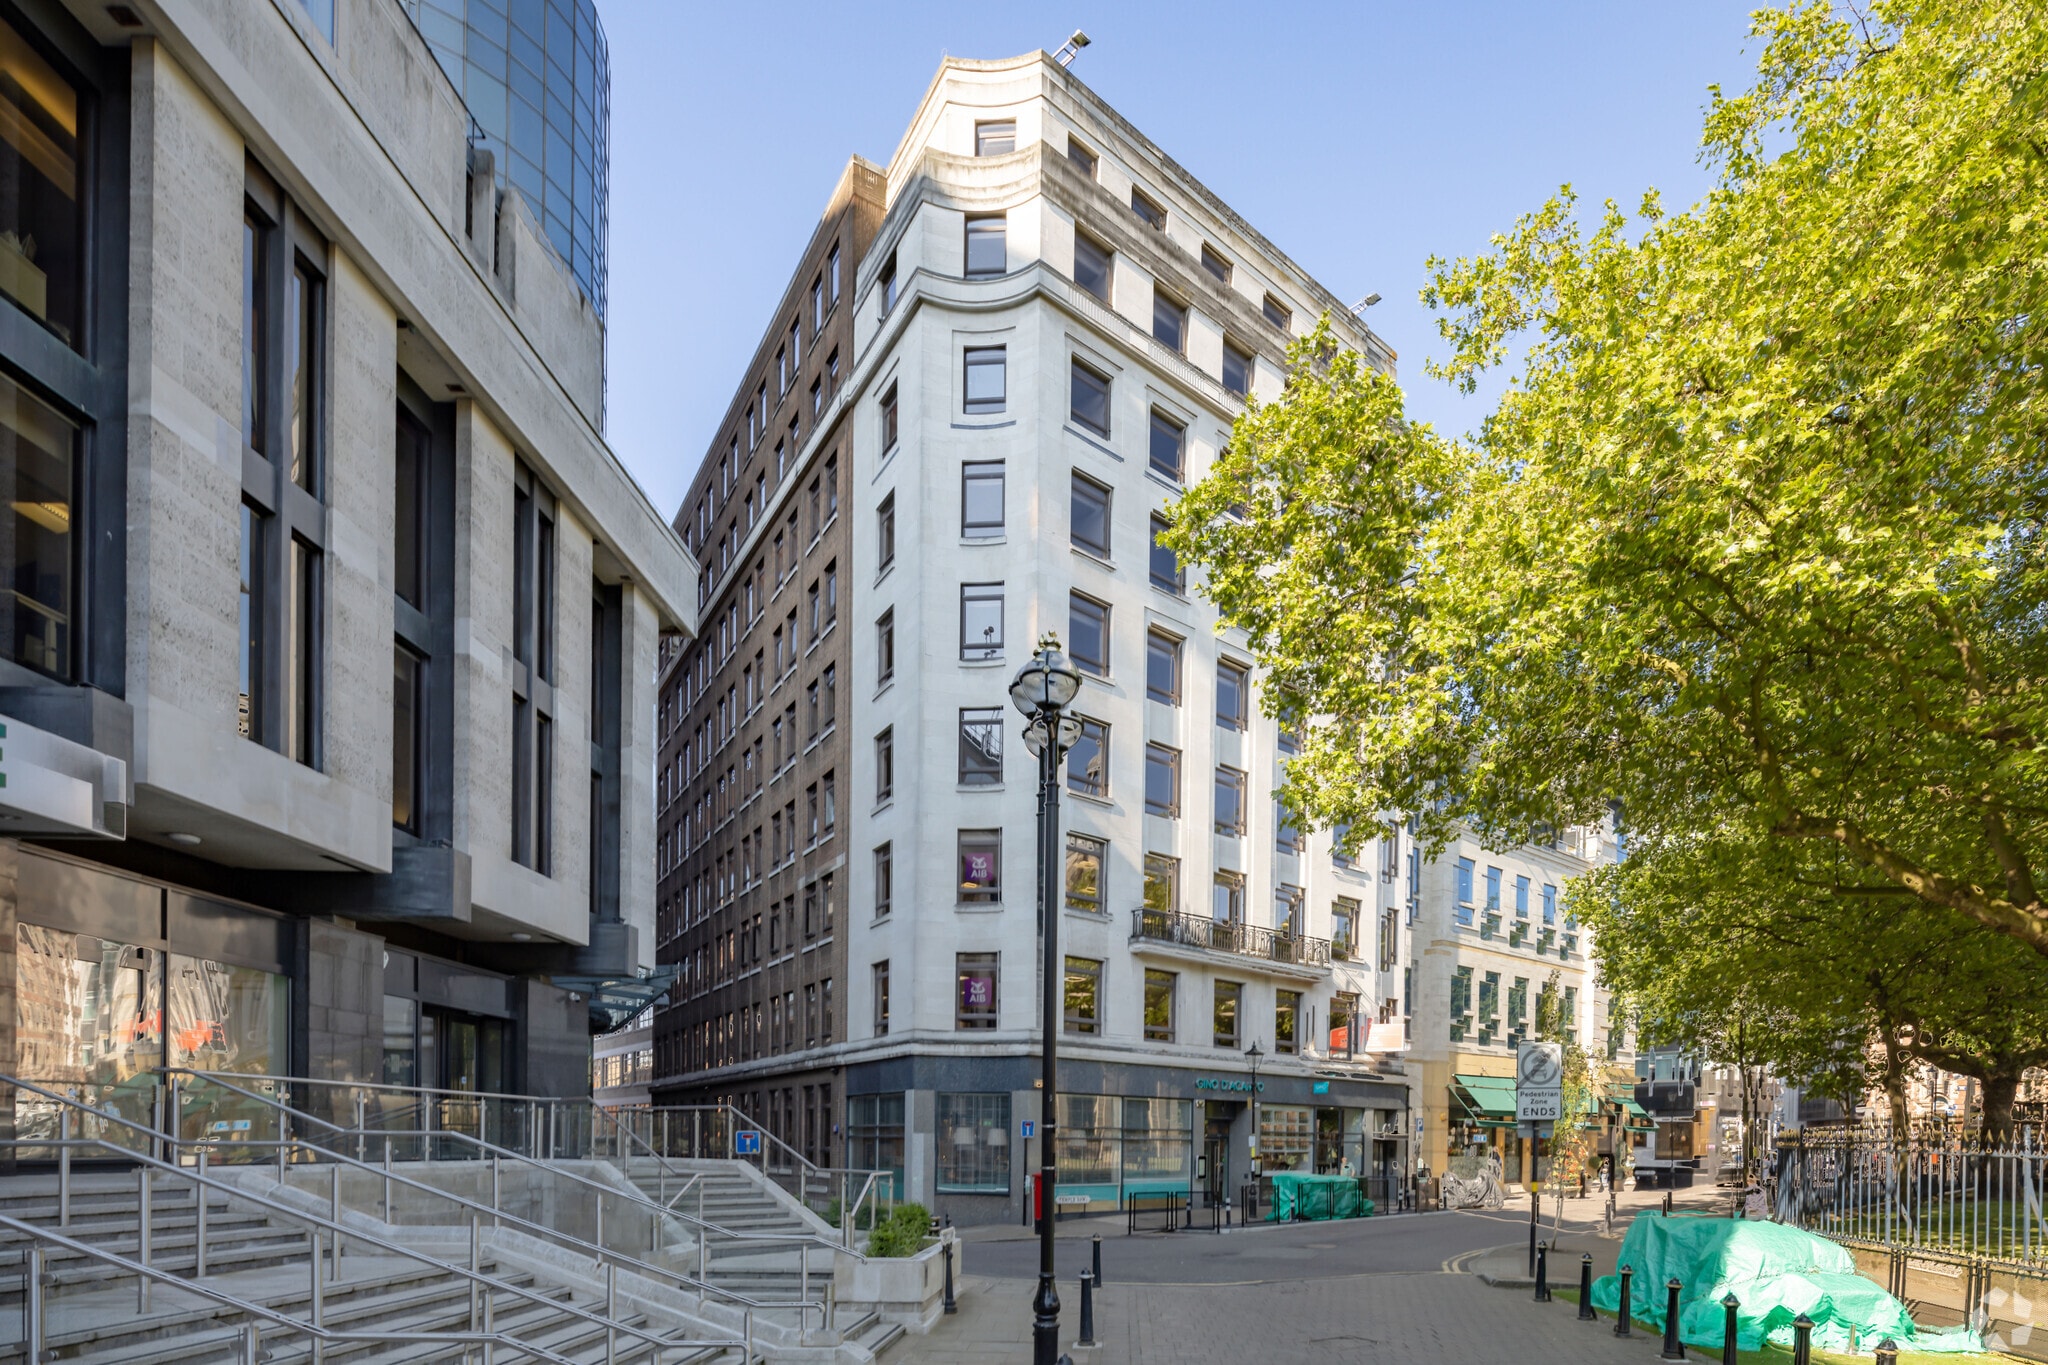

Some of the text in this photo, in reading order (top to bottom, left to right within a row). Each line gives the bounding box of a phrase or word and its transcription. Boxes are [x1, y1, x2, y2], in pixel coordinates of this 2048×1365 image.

[970, 869, 988, 879] AIB
[969, 994, 986, 1003] AIB
[1196, 1078, 1264, 1092] GINO D'ACAMO
[1522, 1107, 1556, 1117] ENDS
